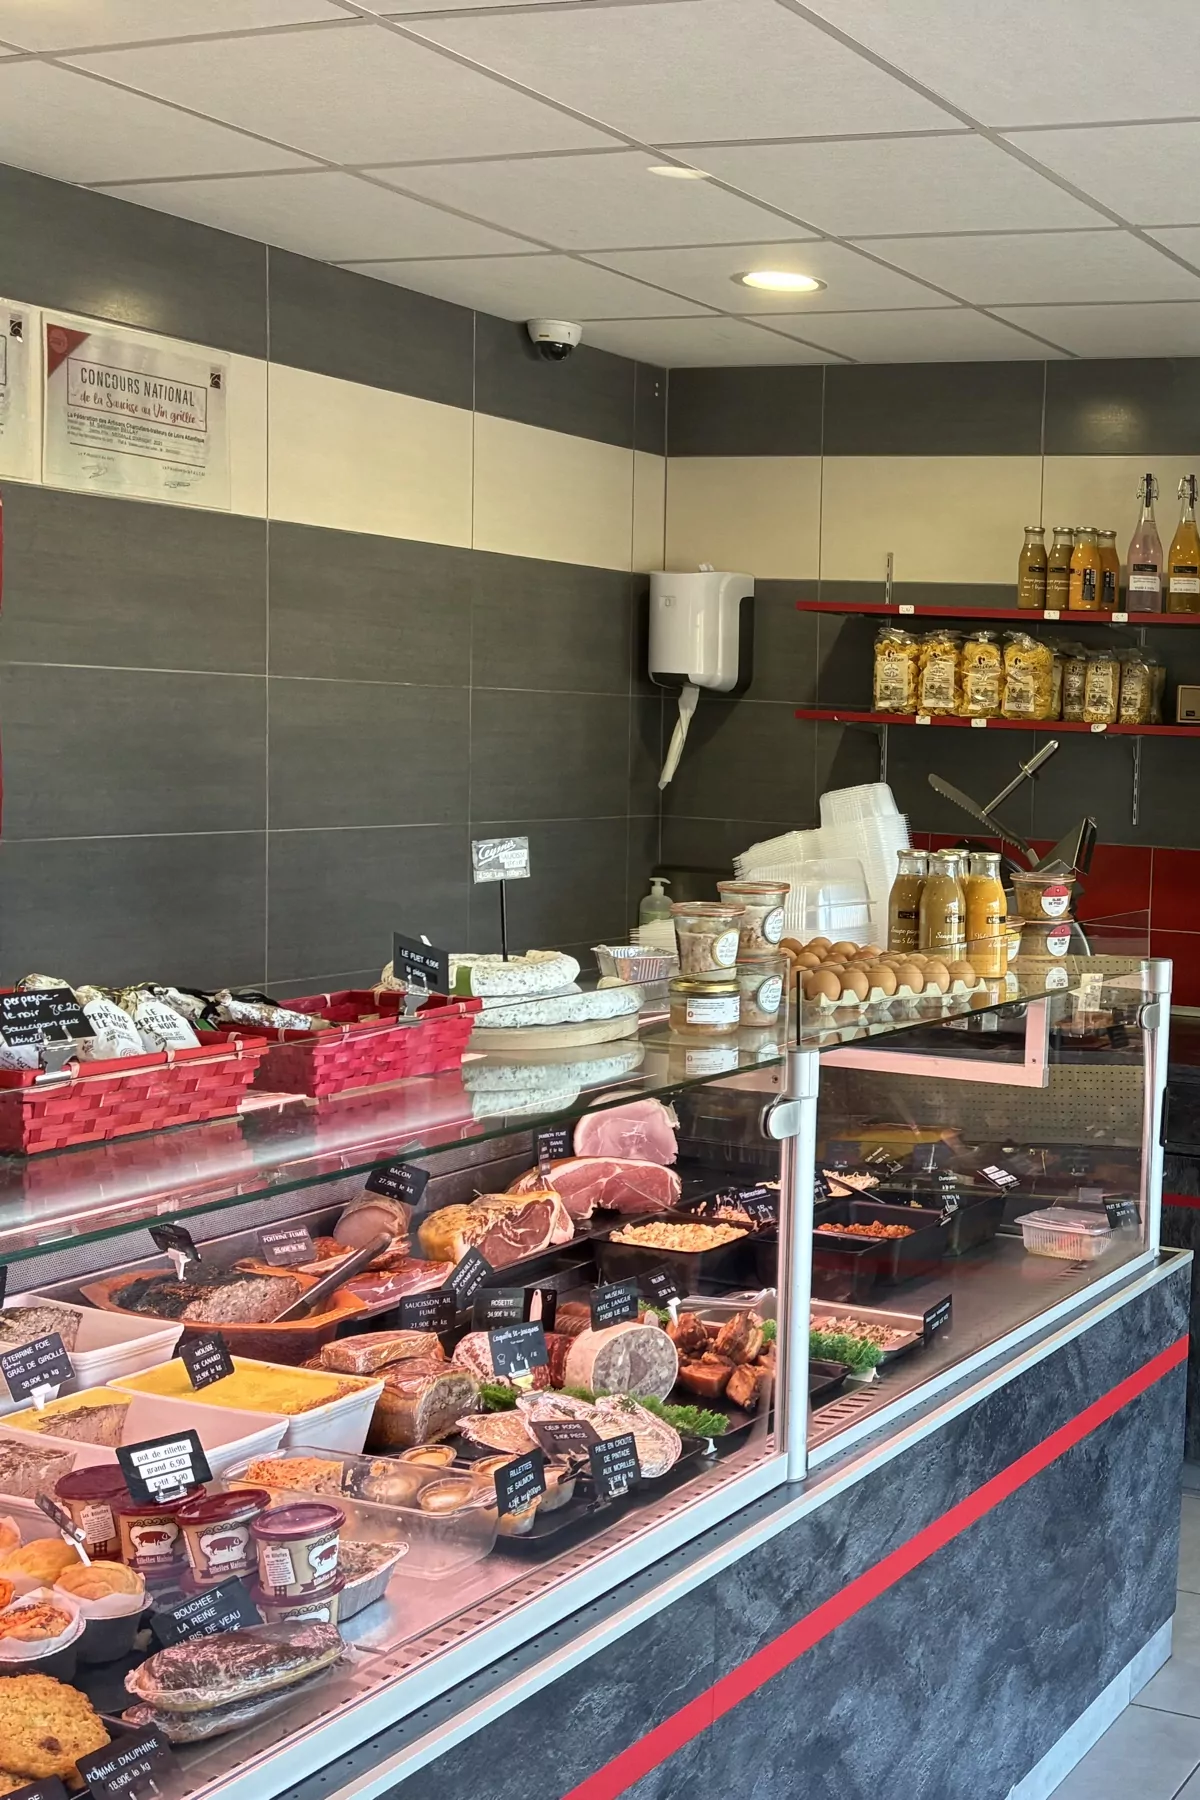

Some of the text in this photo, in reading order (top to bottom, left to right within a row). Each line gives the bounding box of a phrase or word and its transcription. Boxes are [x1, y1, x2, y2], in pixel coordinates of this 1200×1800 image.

[81, 367, 195, 407] CONCOURS NATIONAL
[153, 404, 168, 419] Vin
[401, 949, 425, 964] LE FUET
[3, 1010, 16, 1020] le
[17, 1009, 40, 1019] noir
[100, 1004, 110, 1013] LE
[145, 1008, 157, 1017] LE
[2, 1018, 80, 1035] Saucisson aux
[86, 1014, 129, 1024] PERPEZAC
[133, 1014, 178, 1029] PERPEZAC
[389, 1167, 413, 1180] BACON
[451, 1259, 475, 1288] ANDOUILLE
[459, 1260, 482, 1288] CAMPAGNE
[404, 1299, 440, 1310] SAUCISSON
[490, 1299, 515, 1307] ROSETTE
[492, 1332, 512, 1345] Coquille
[7, 1338, 51, 1363] TERRINE FOIE
[194, 1343, 214, 1357] MOUSSE
[6, 1347, 65, 1379] GRAS DE GIROLLE
[193, 1353, 221, 1371] DE CANARD
[42, 1371, 50, 1380] le
[594, 1435, 633, 1454] PATE EN CROUTE
[136, 1444, 187, 1463] pot de rillette
[603, 1448, 632, 1463] DE PINTADE
[146, 1463, 167, 1475] grand
[509, 1460, 533, 1479] RILLETTES
[602, 1458, 636, 1476] AUX MORILLES
[506, 1472, 535, 1496] DE SAUMON
[173, 1590, 224, 1620] BOUCHEE A
[176, 1607, 218, 1634] LA REINE
[204, 1623, 219, 1634] DE
[218, 1609, 241, 1627] VEAU
[118, 1738, 159, 1766] DAUPHINE
[132, 1761, 152, 1778] le kg
